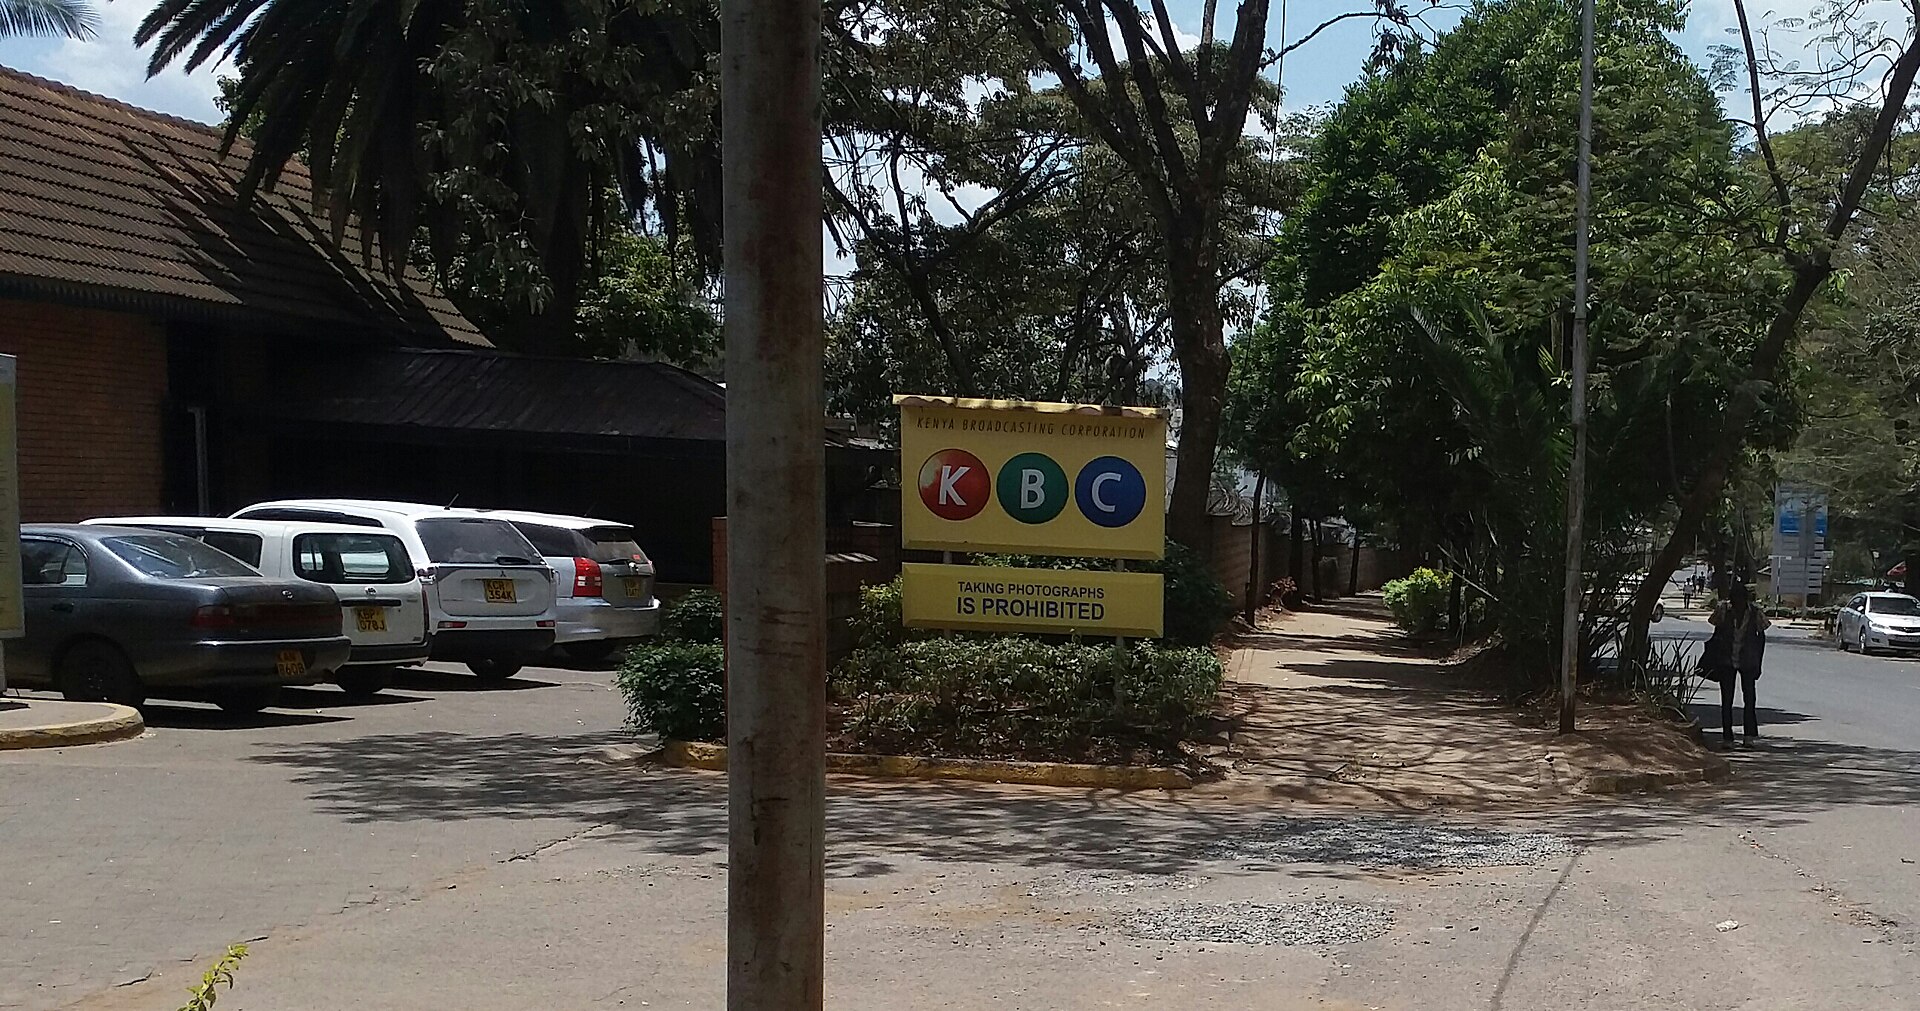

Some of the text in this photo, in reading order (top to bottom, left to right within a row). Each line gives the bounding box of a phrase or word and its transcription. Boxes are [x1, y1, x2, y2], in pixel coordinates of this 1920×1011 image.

[917, 417, 1145, 439] KENYA BROADCASTING CORPORATION
[938, 465, 1121, 513] K B C
[488, 590, 513, 601] 354K
[958, 581, 1105, 599] TAKING PHOTOGRAPHS
[957, 597, 1105, 620] IS PROHIBITED
